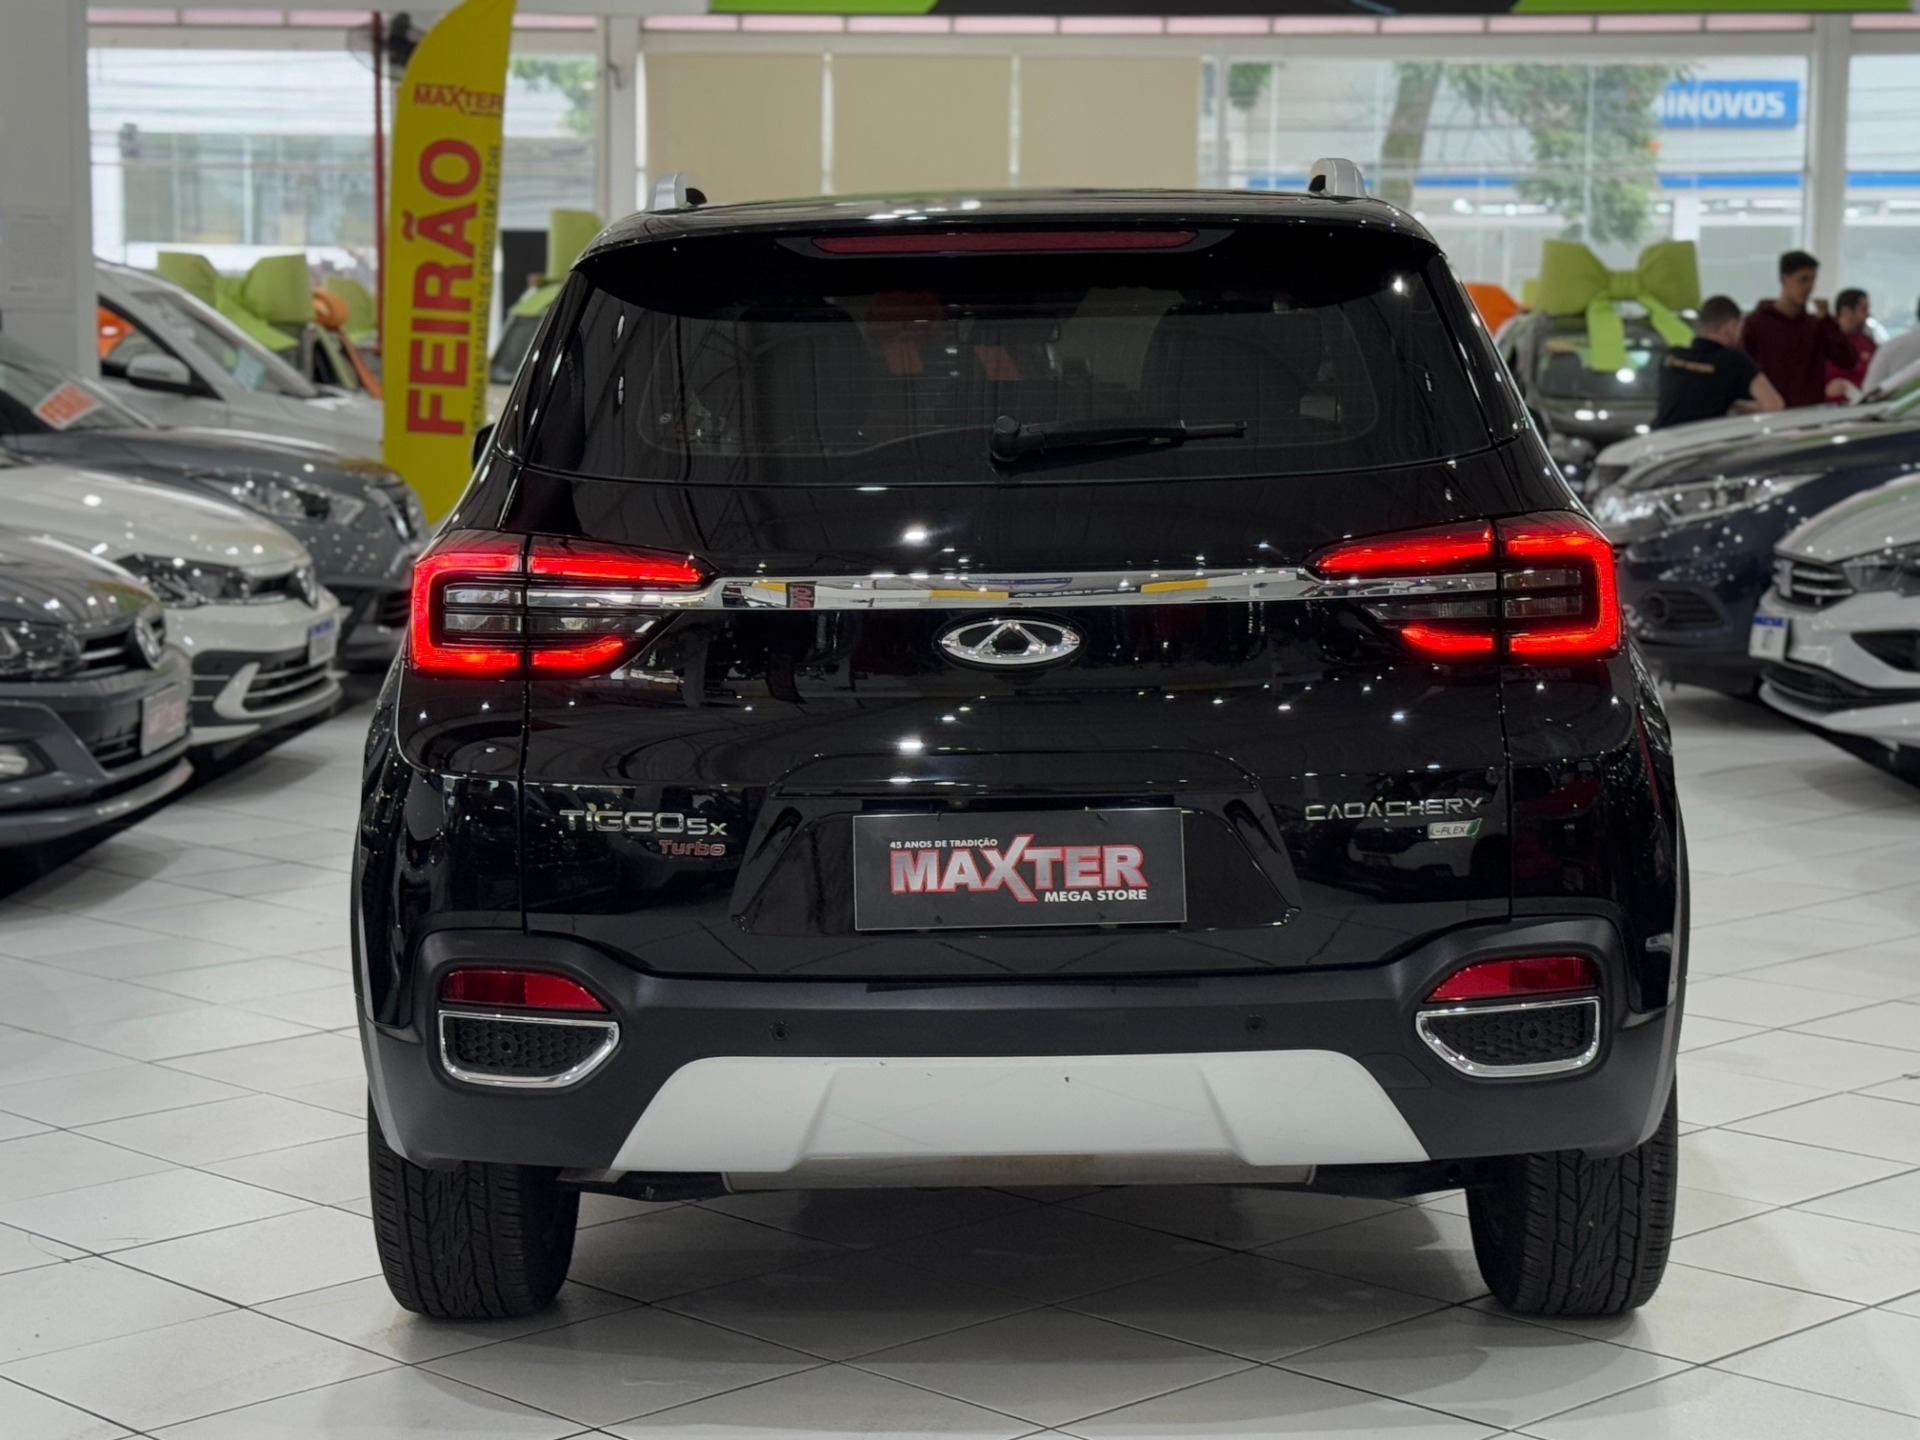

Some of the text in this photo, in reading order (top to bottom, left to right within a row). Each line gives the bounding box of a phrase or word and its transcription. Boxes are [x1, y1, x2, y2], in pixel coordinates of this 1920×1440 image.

[402, 138, 482, 436] FEIRÃO
[659, 839, 726, 856] Turbo
[890, 837, 998, 849] 45 ANOS DE TRADIÇÃO
[890, 834, 1148, 902] MAXTER
[1044, 889, 1148, 902] MEGA STORE
